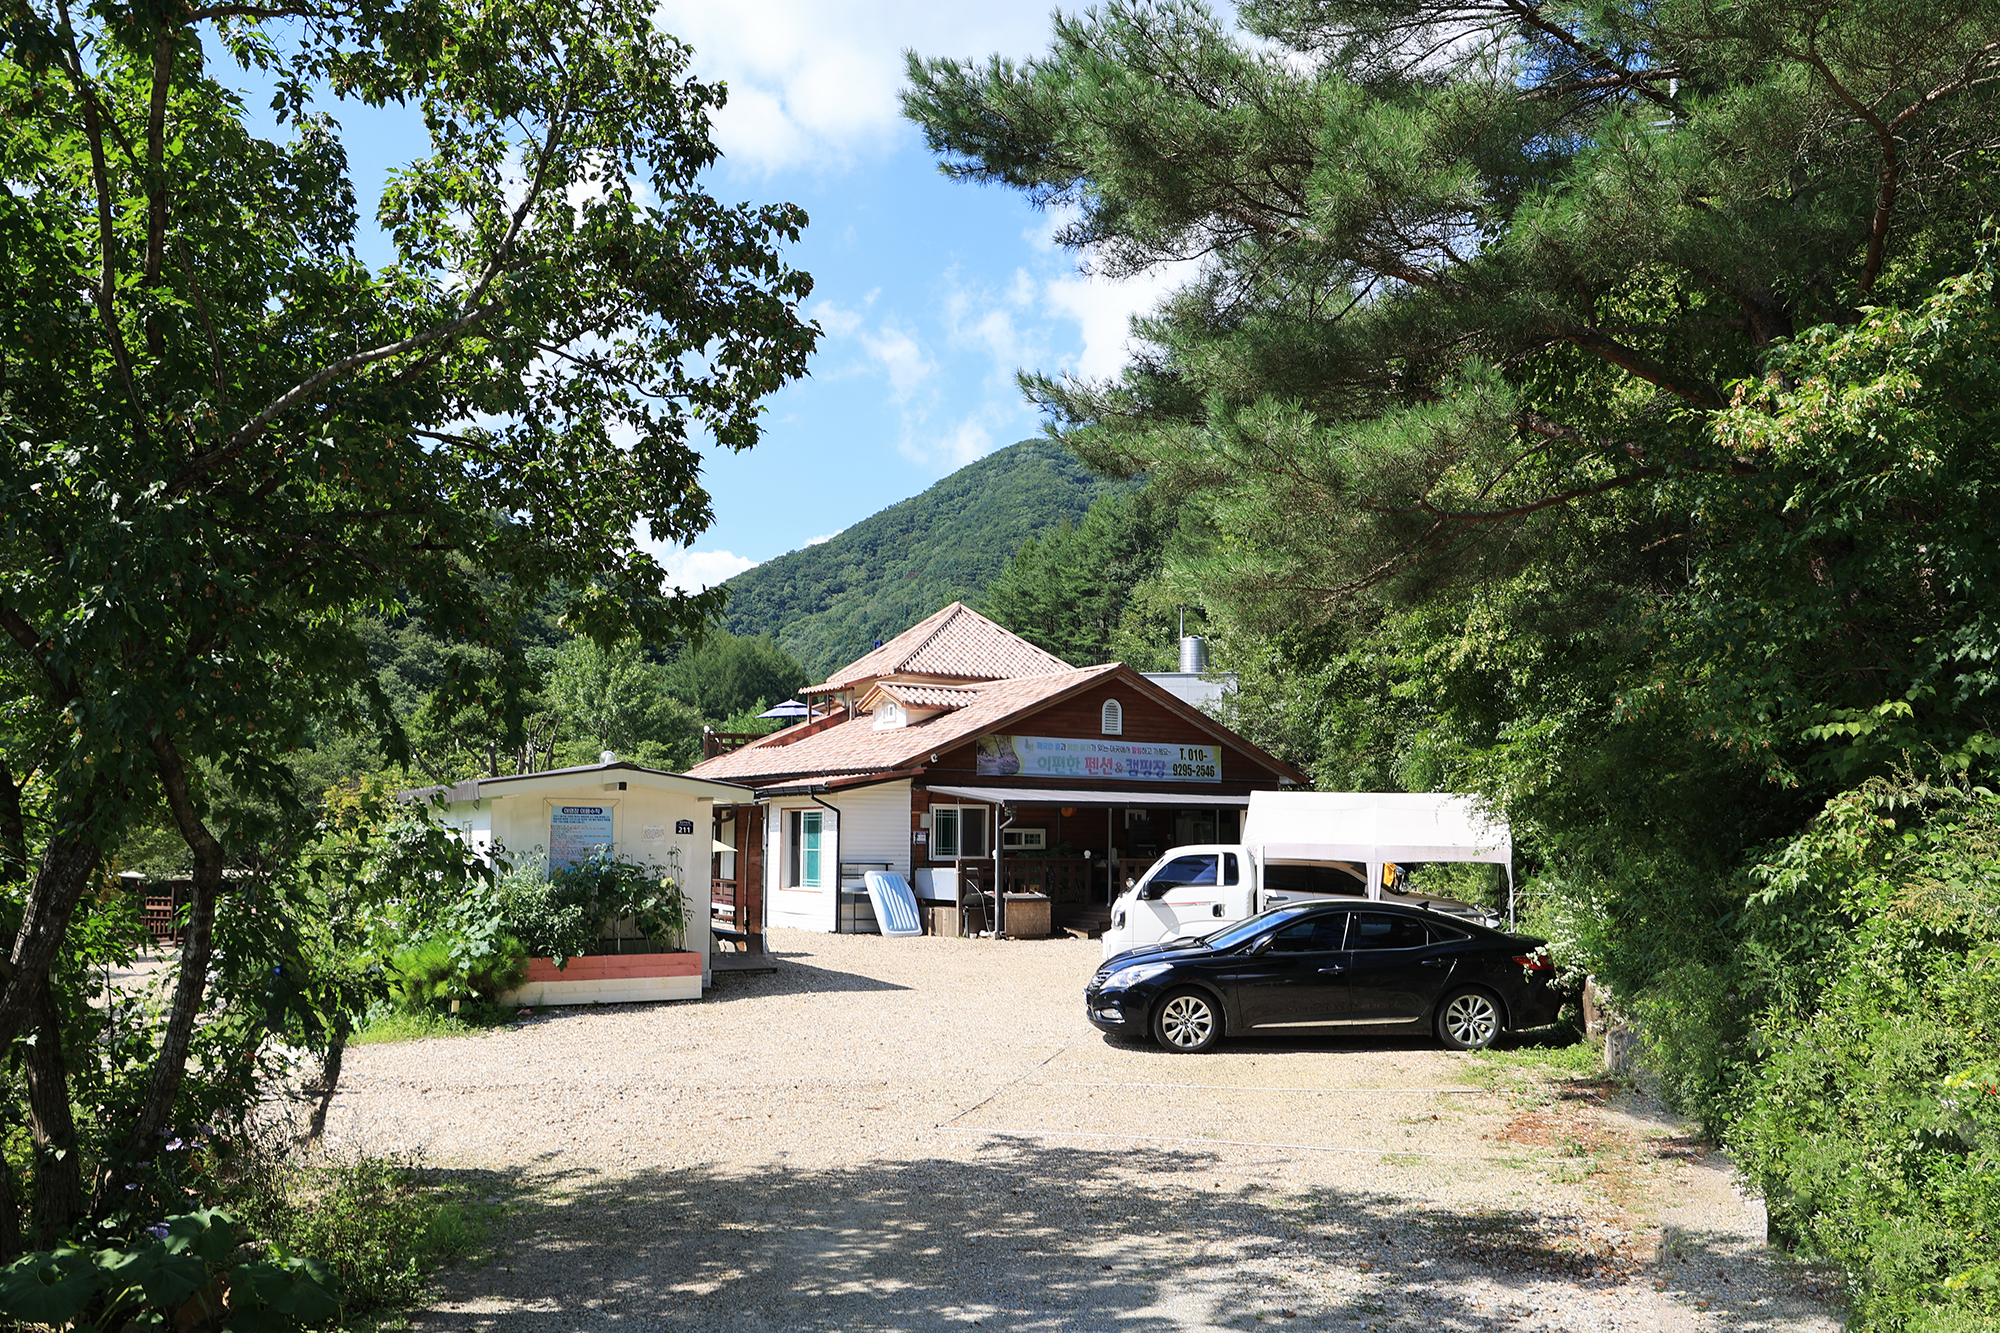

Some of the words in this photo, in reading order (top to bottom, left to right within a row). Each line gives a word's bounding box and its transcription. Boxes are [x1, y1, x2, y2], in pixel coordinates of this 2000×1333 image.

[1037, 755, 1080, 775] 이편한
[1126, 758, 1166, 778] 캠핑장
[1172, 763, 1215, 778] 9295-2546
[678, 826, 691, 834] 211
